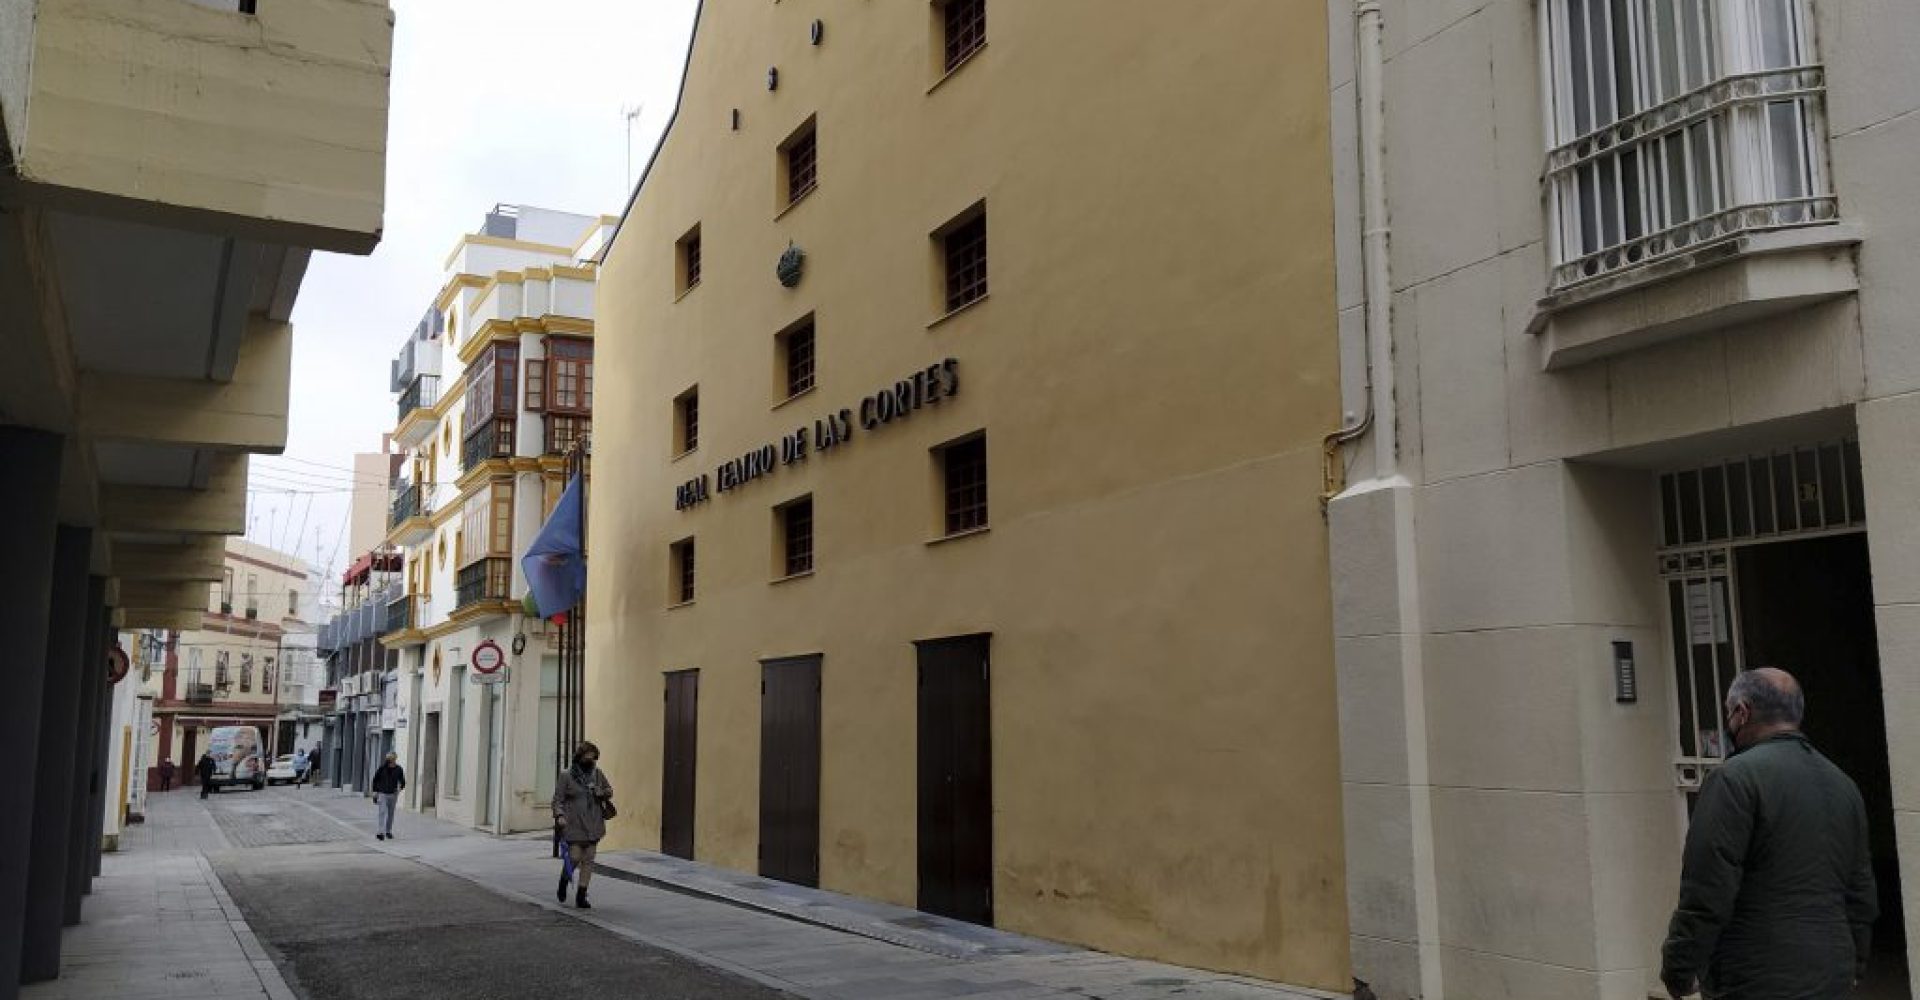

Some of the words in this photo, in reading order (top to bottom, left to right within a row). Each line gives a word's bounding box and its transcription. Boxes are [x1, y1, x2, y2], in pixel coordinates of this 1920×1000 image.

[675, 474, 709, 511] REAL
[716, 444, 776, 493] TEATRO
[781, 426, 808, 466] DE
[815, 408, 852, 451] LAS
[859, 357, 960, 431] CORTES
